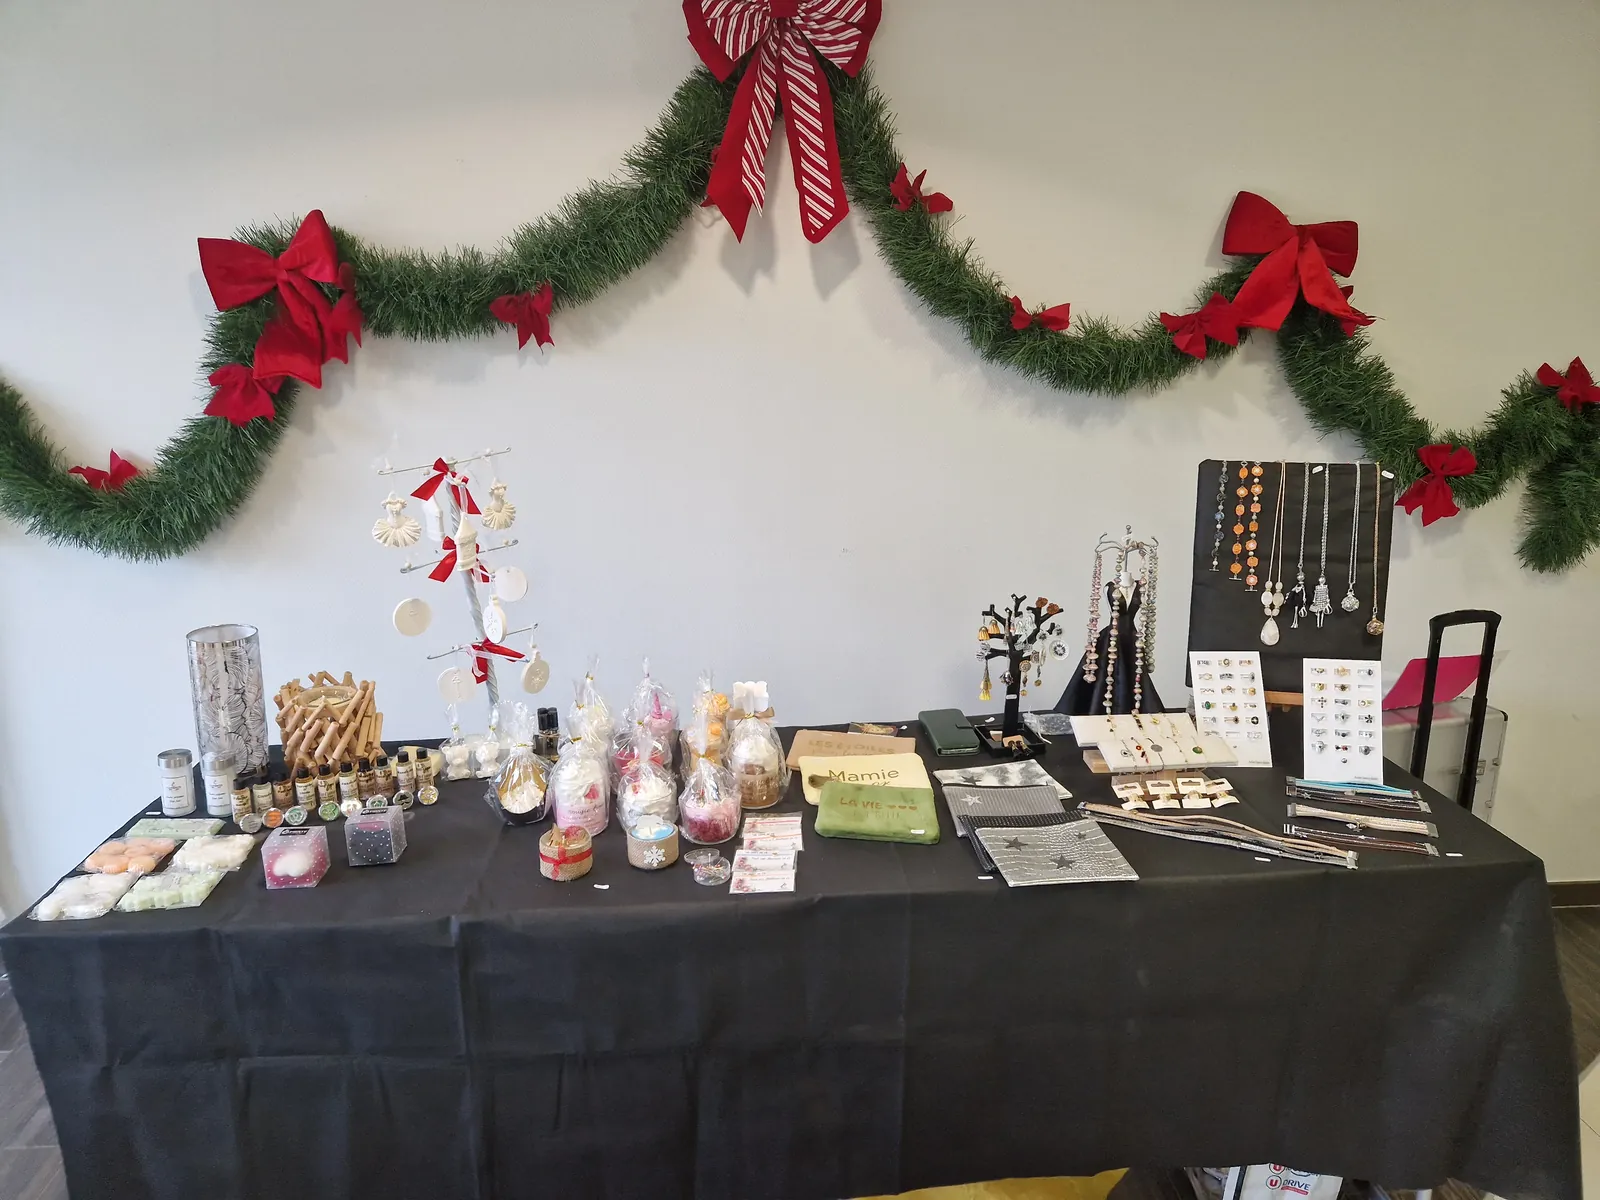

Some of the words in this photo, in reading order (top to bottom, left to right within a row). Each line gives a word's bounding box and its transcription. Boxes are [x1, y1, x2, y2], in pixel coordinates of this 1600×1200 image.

[808, 740, 832, 748] LES
[828, 769, 899, 782] Mamie
[840, 797, 858, 807] LA
[862, 800, 882, 809] VIE
[1283, 1179, 1311, 1191] DRIVE
